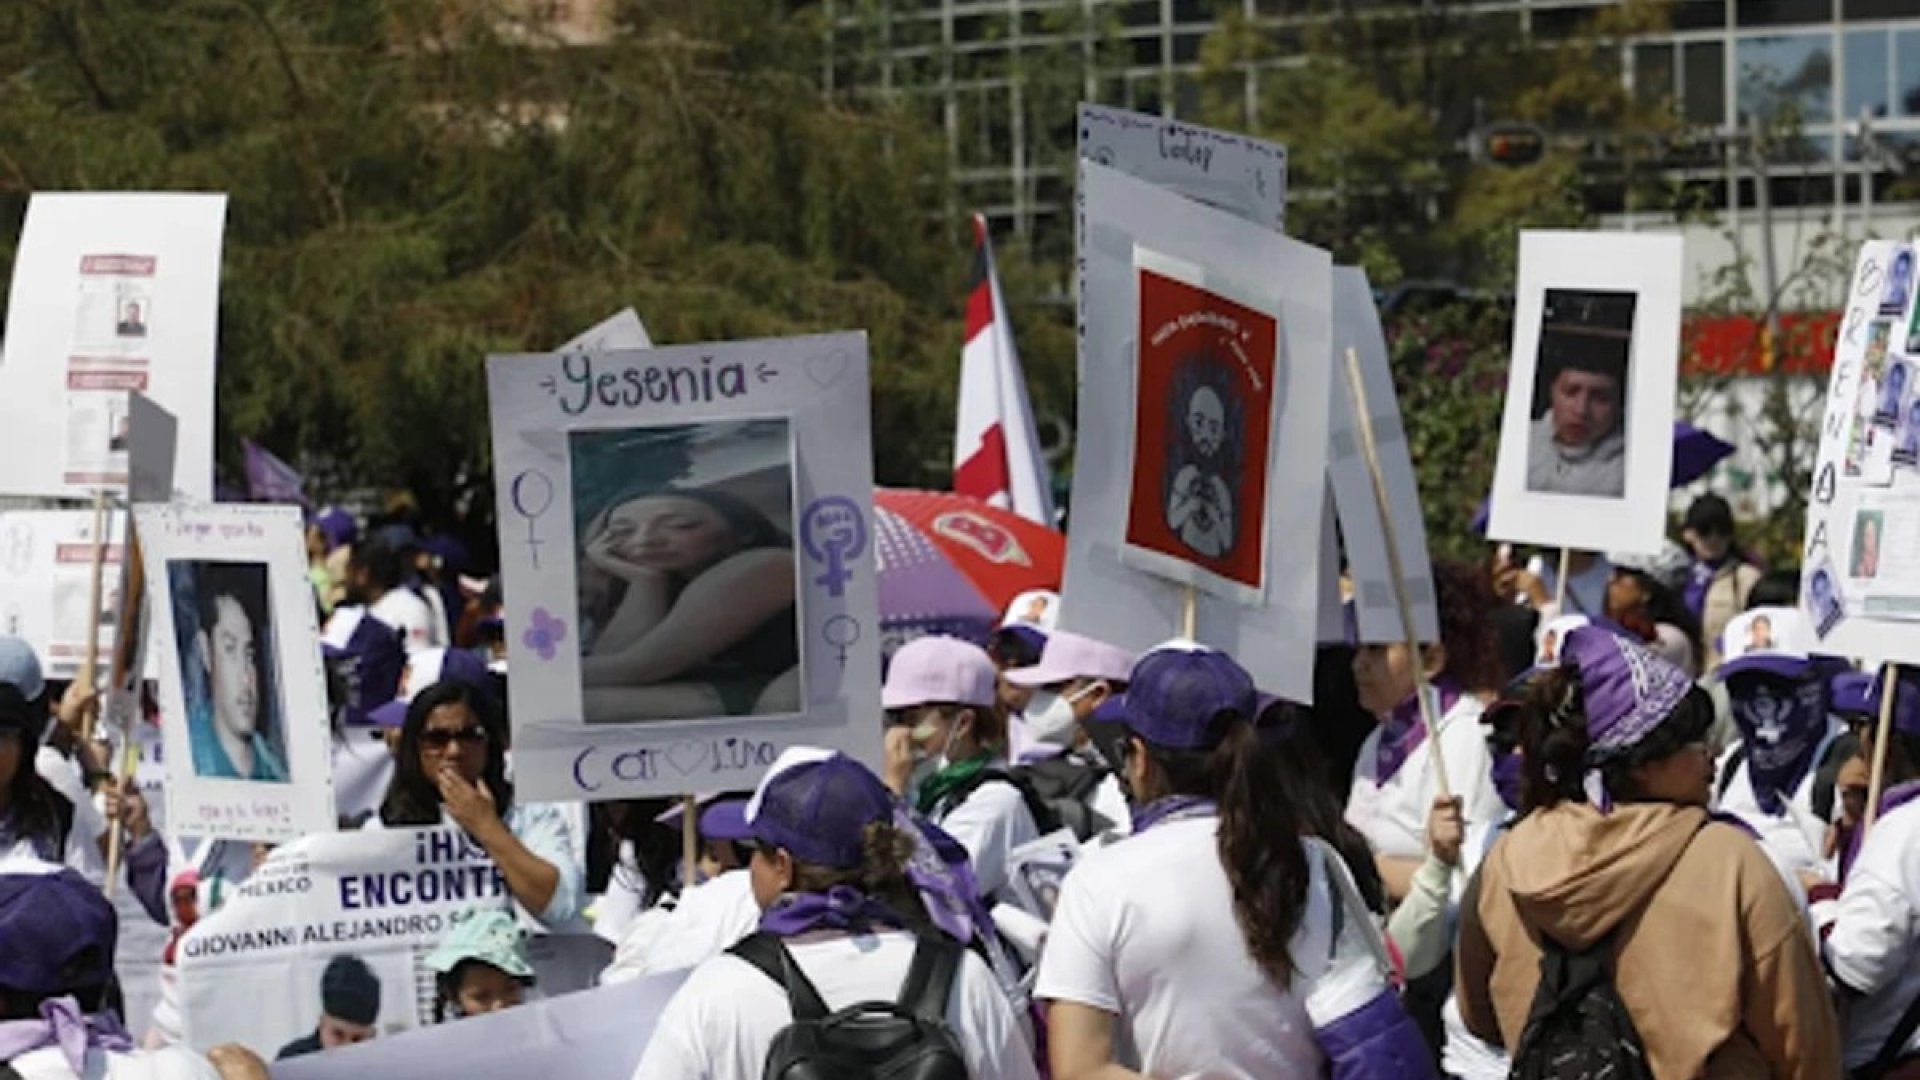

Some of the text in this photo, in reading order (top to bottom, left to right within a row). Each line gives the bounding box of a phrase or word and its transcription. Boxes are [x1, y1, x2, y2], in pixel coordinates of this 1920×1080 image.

[559, 354, 748, 416] Yesenia
[339, 865, 513, 910] ENCONTR
[183, 928, 296, 958] GIOVANNI
[303, 914, 442, 944] ALEJANDRO
